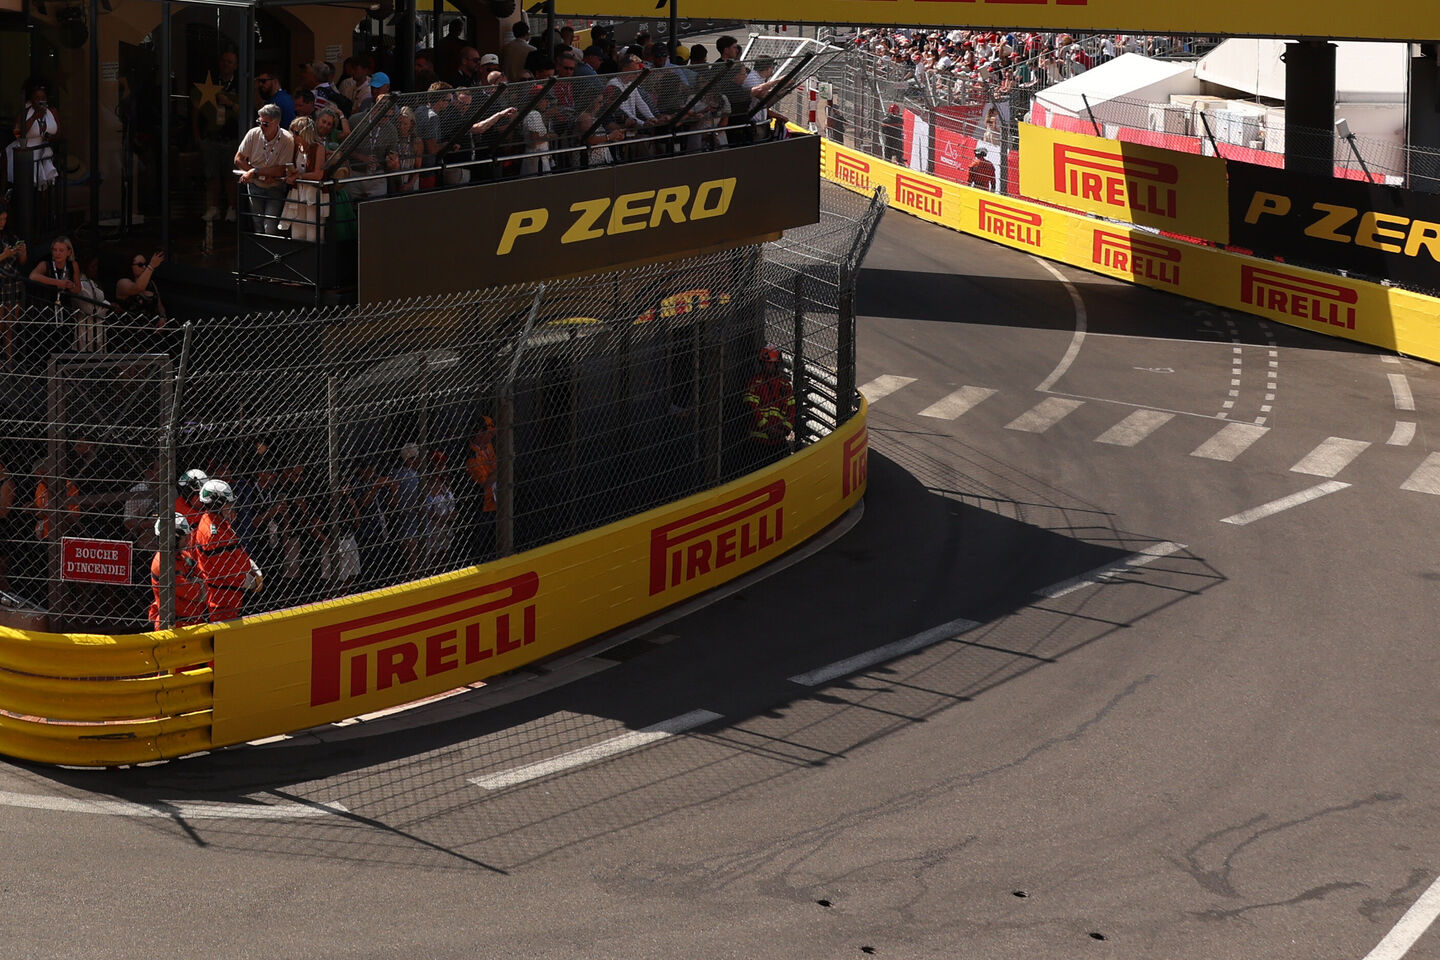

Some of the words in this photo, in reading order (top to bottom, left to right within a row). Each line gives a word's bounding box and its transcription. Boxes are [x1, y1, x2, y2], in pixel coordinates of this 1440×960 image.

[835, 152, 870, 190] PIRELLI
[896, 173, 942, 217] PIRELLI
[1053, 142, 1178, 219] PIRELLI
[496, 208, 549, 255] P
[560, 177, 737, 243] ZERO
[979, 199, 1042, 247] PIRELLI
[1244, 191, 1291, 225] P
[1304, 202, 1440, 263] ZER
[1092, 229, 1181, 286] PIRELLI
[1241, 264, 1358, 330] PIRELLI
[75, 548, 119, 560] BOUCHE
[649, 478, 785, 596] PIRELLI
[67, 562, 126, 576] D'INCENDIE
[311, 571, 539, 707] PIRELLI
